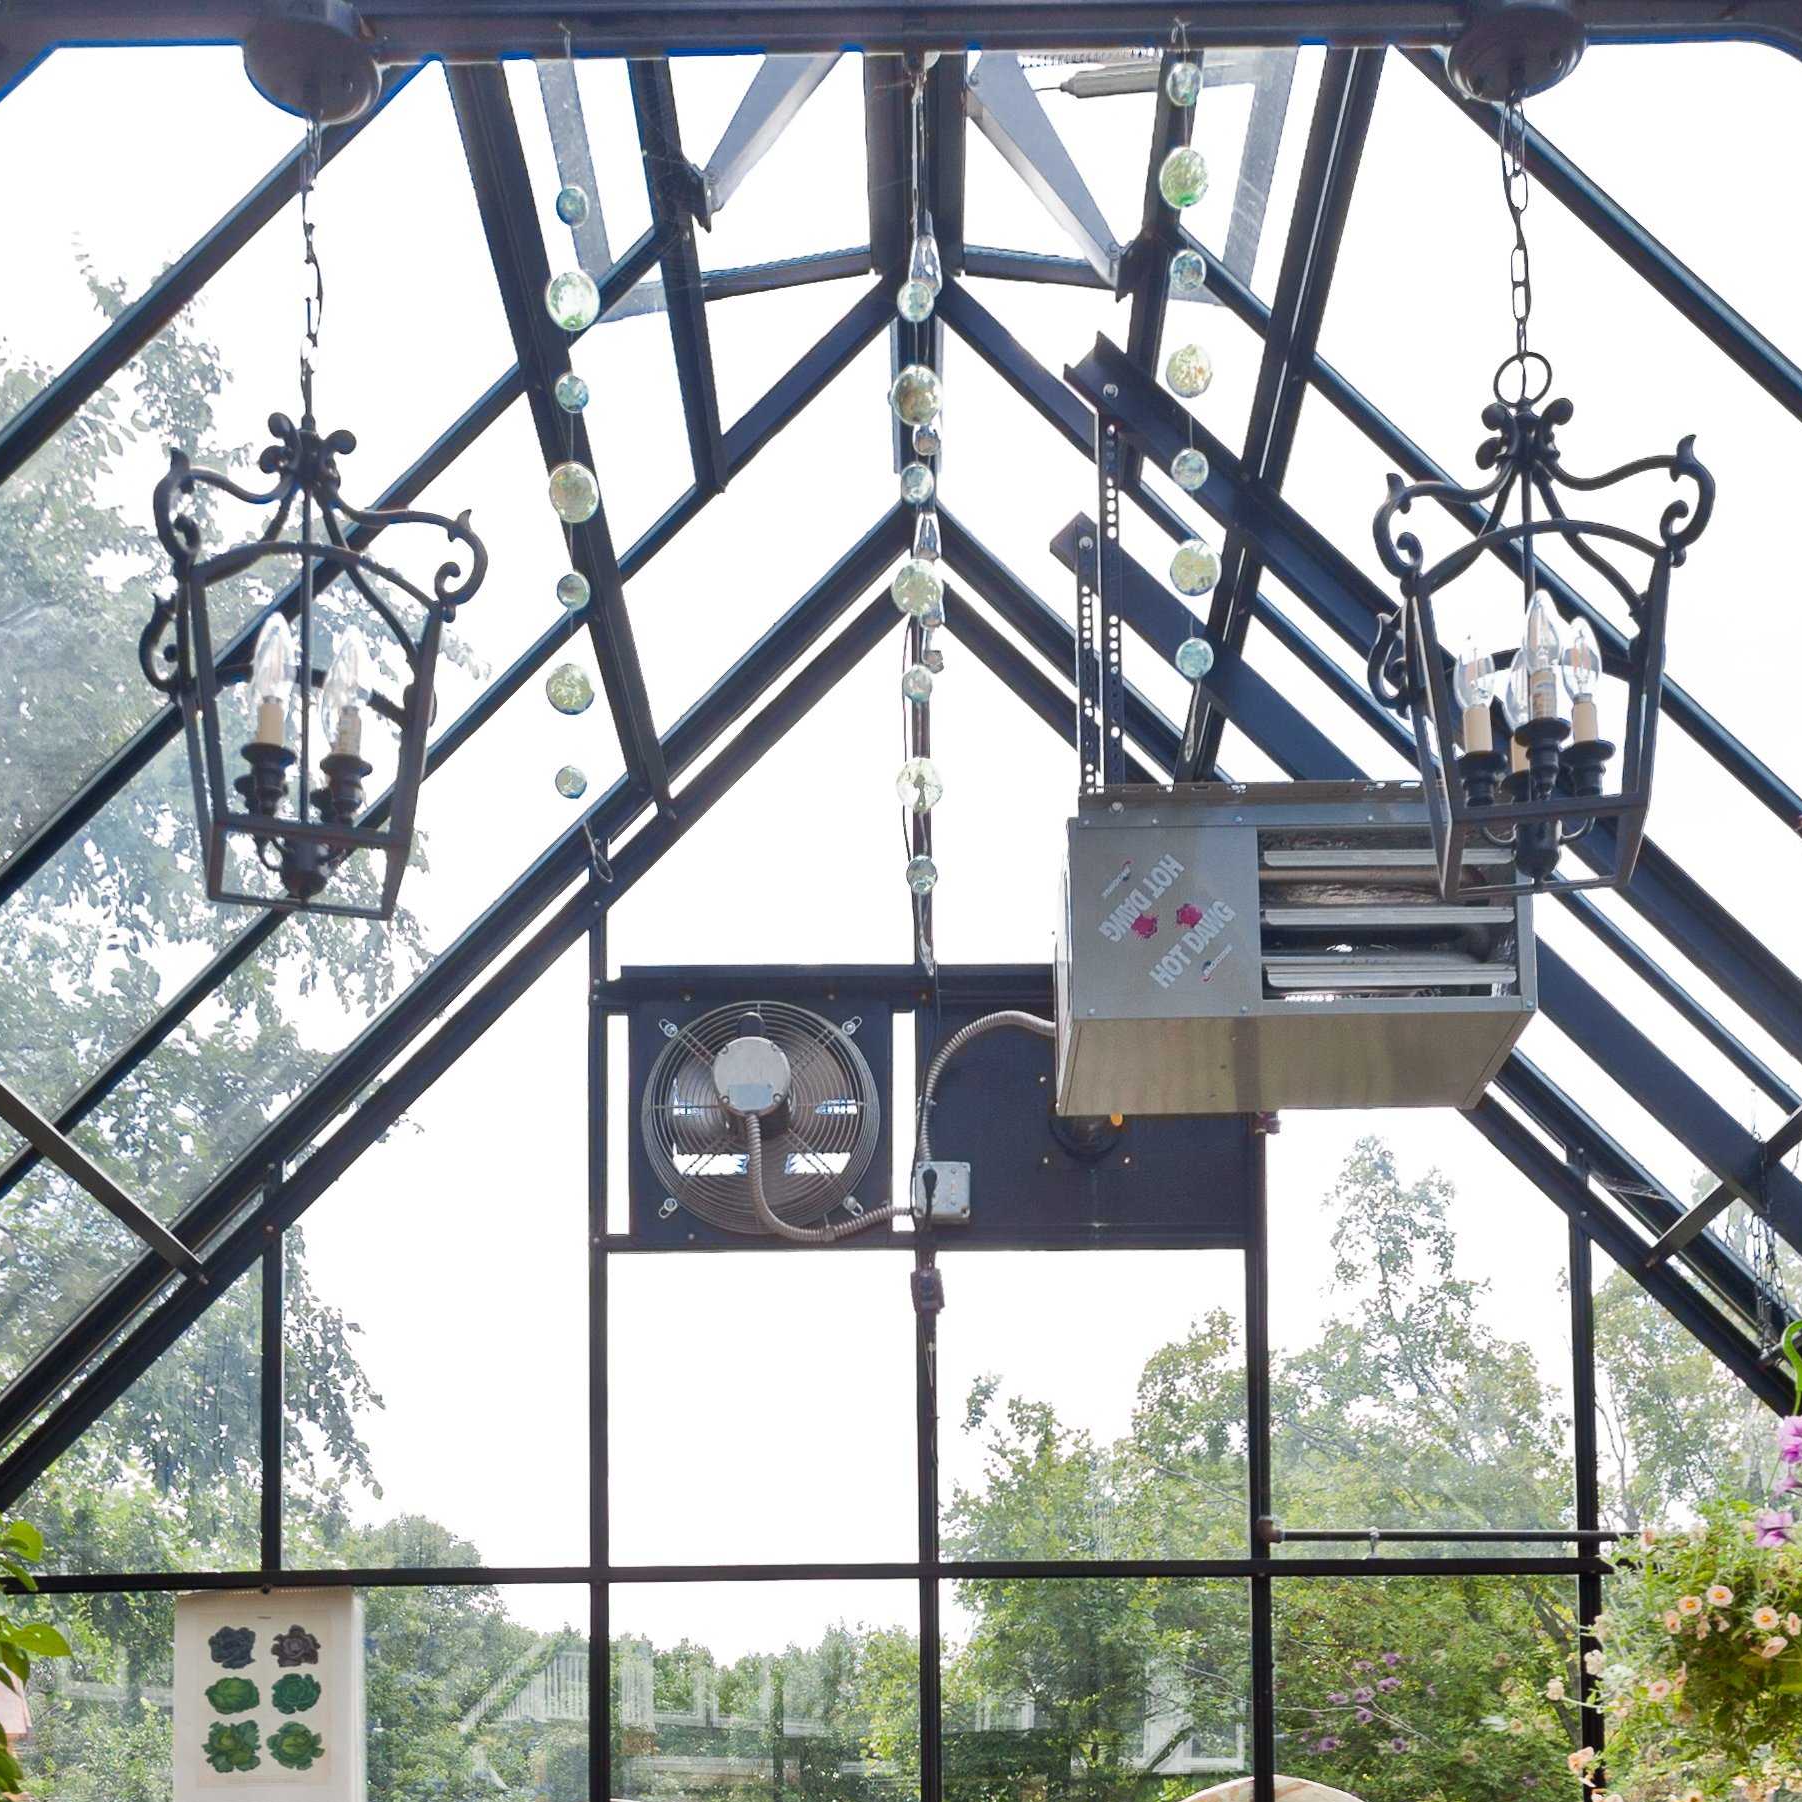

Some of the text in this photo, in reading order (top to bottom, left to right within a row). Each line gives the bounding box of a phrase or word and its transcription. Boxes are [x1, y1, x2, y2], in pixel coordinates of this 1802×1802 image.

[1099, 854, 1185, 942] HOT DAWG
[1149, 901, 1236, 989] HOT DAWG
